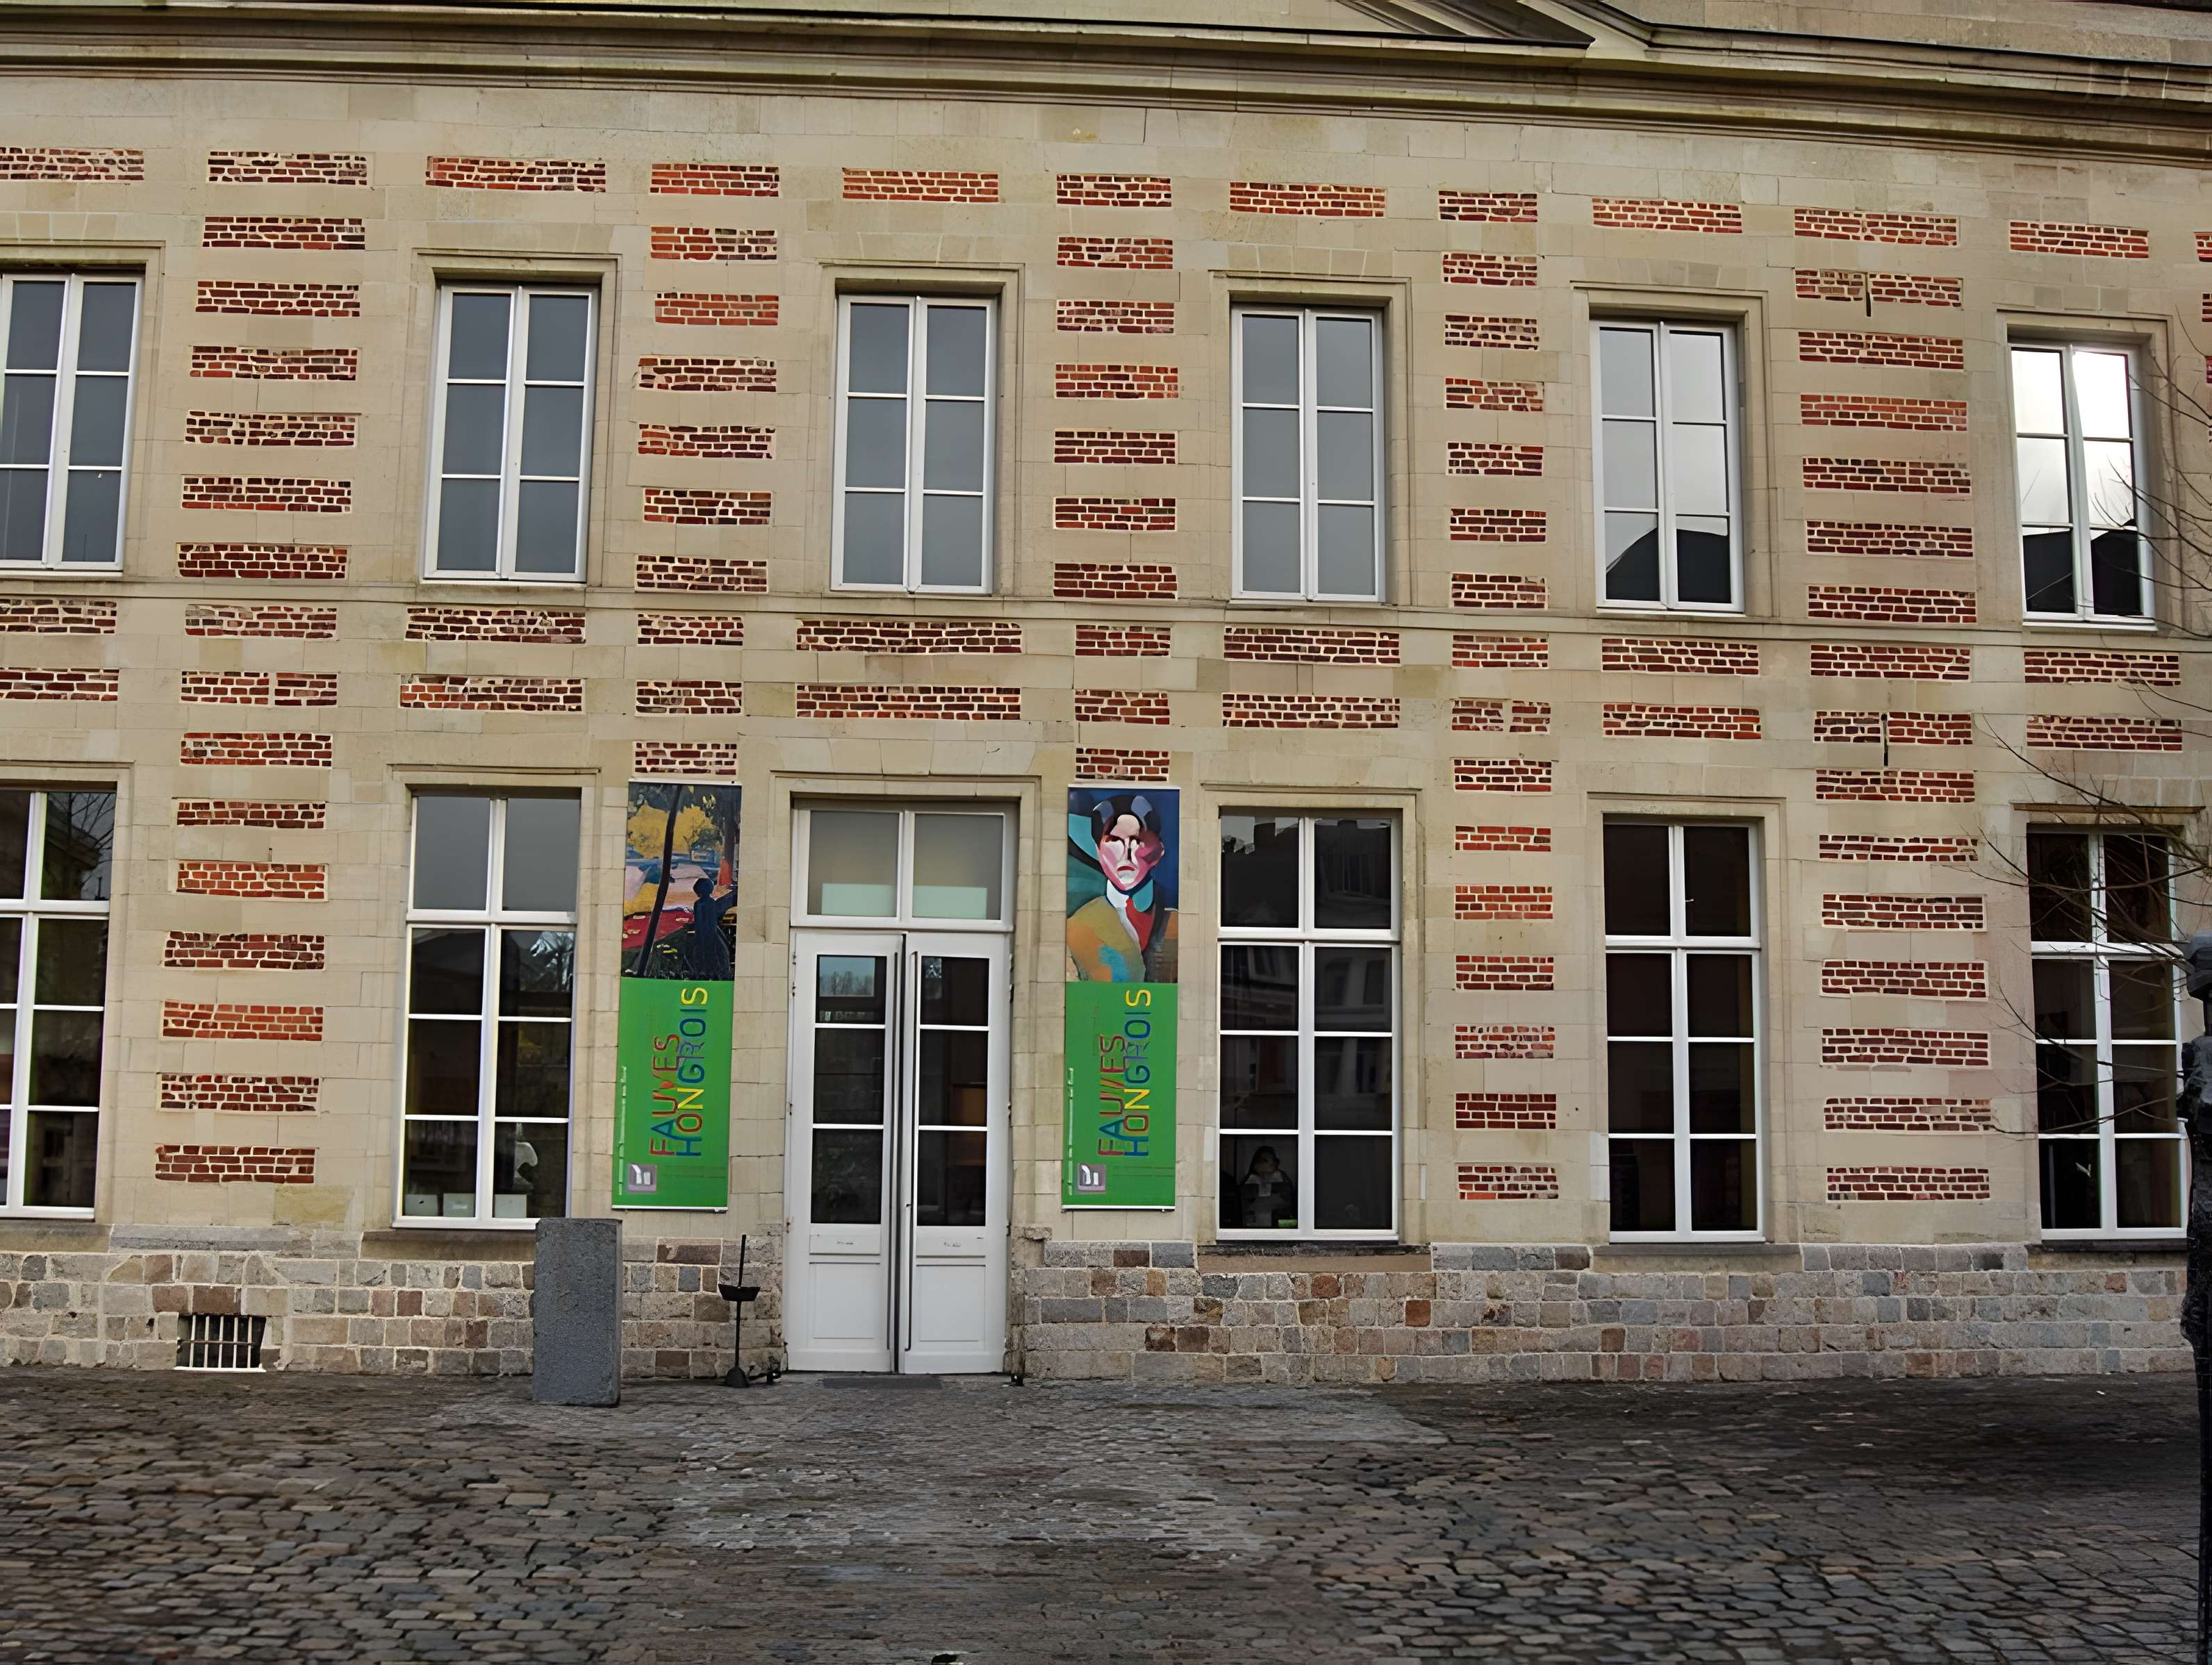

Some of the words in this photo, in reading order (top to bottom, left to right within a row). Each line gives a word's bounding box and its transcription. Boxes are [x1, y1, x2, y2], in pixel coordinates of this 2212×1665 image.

[650, 1034, 679, 1156] FAUVES
[675, 987, 708, 1156] HONGROIS
[1098, 1034, 1125, 1156] FAUVES
[1123, 989, 1151, 1157] HONGROIS
